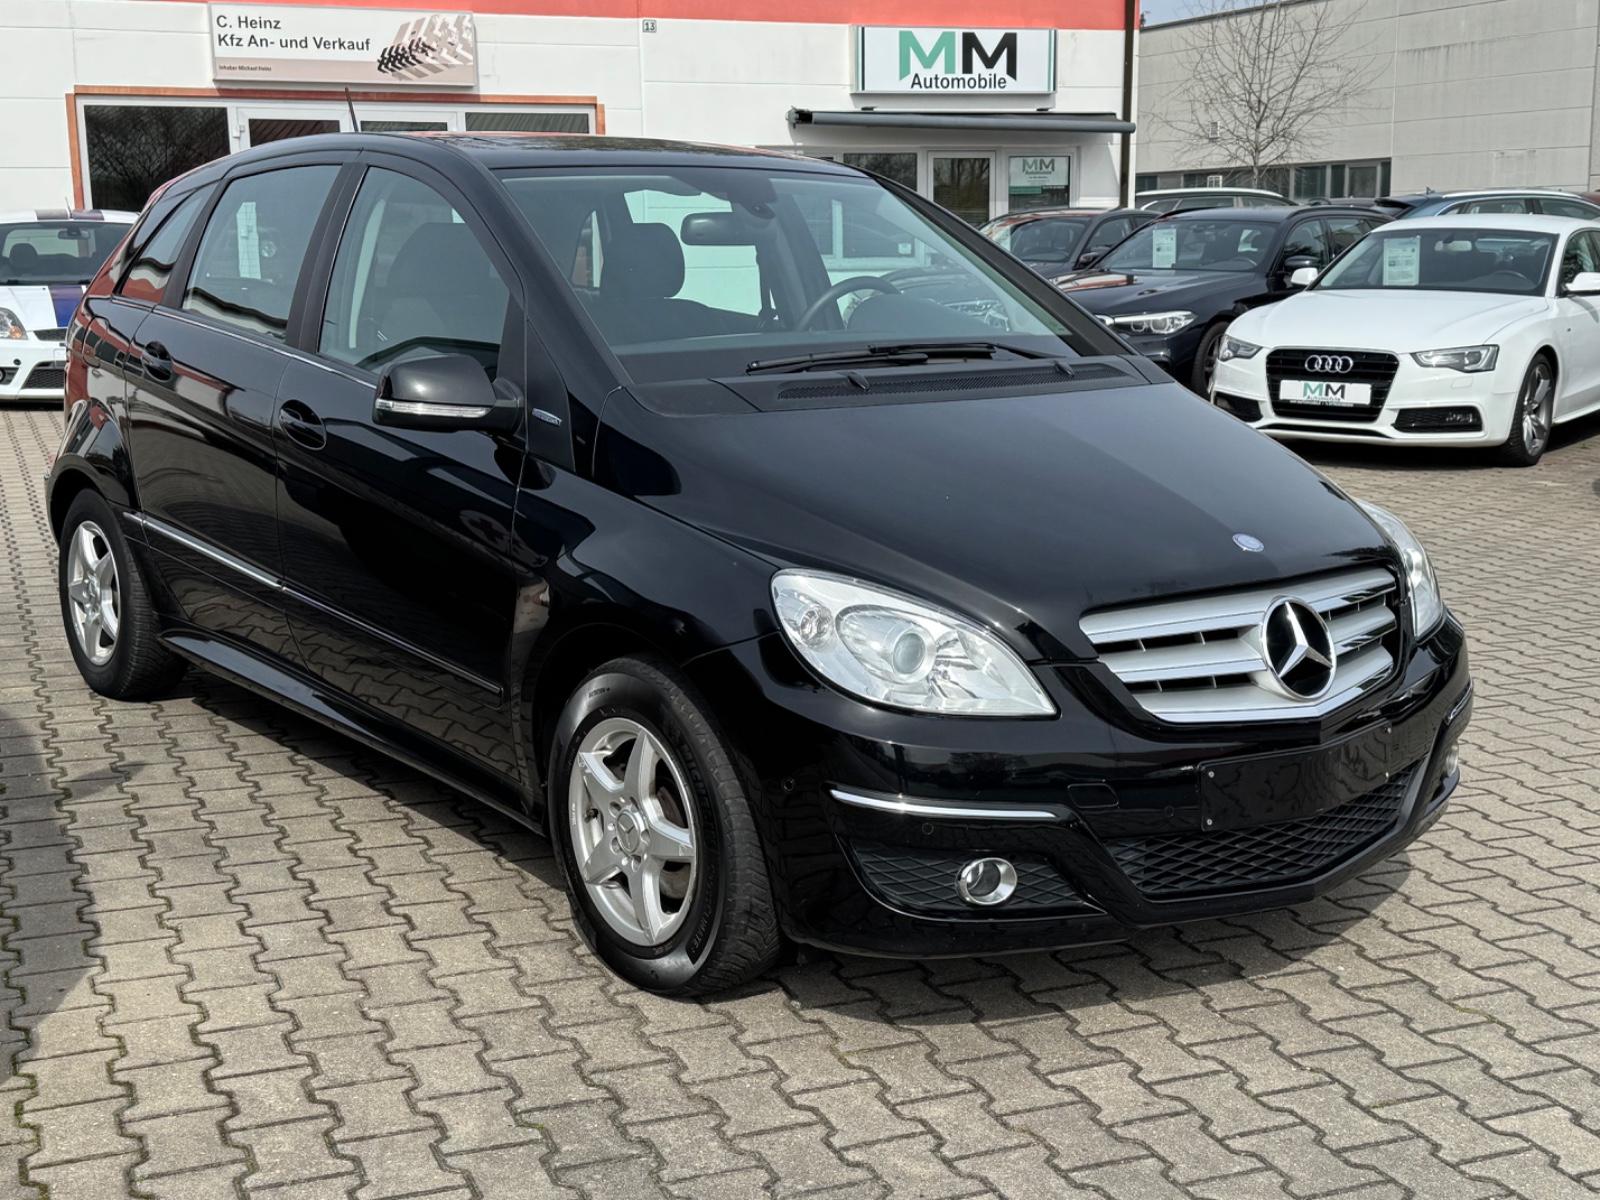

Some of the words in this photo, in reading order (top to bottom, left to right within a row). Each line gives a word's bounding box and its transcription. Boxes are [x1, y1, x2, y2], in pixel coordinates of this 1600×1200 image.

[216, 15, 233, 29] C.
[237, 16, 282, 30] Heinz
[645, 22, 655, 31] 13
[217, 34, 244, 47] Kfz
[247, 35, 275, 48] An-
[279, 37, 309, 49] und
[313, 37, 371, 51] Verkauf
[899, 30, 1017, 81] MM
[910, 73, 1007, 90] Automobile
[1022, 158, 1055, 173] MM
[1303, 382, 1345, 400] MM
